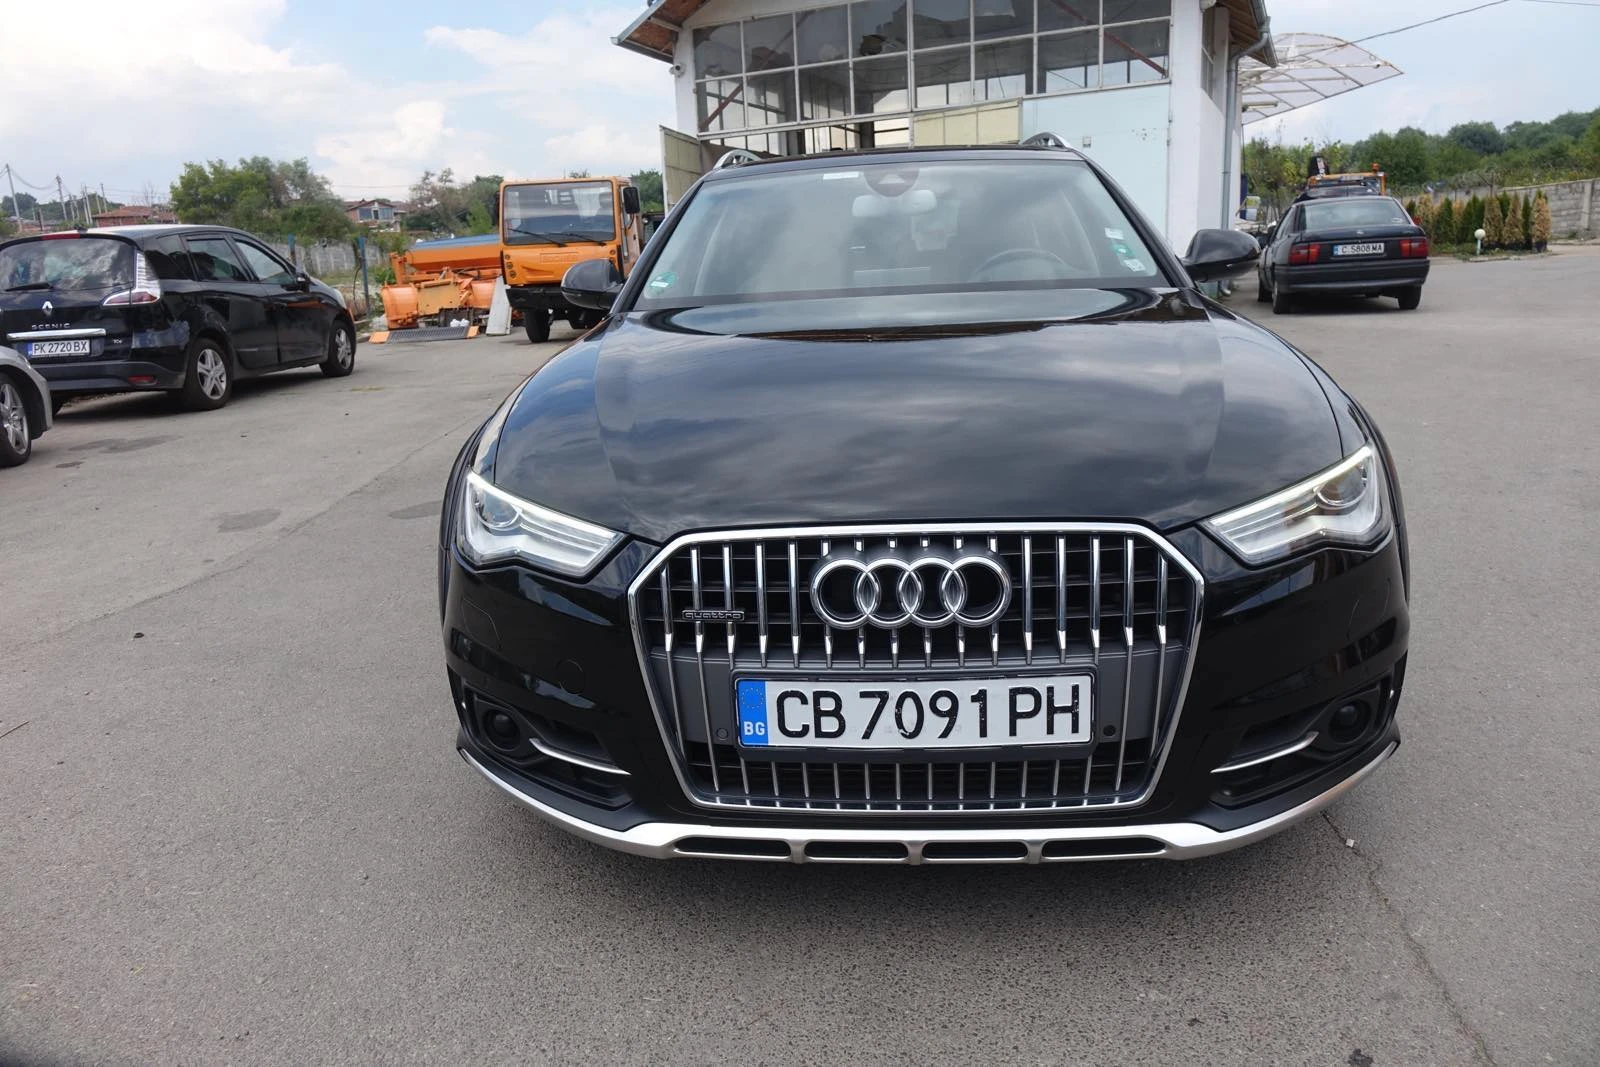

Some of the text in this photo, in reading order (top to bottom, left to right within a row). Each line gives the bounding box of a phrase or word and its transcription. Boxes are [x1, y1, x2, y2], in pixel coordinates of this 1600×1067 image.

[34, 343, 46, 354] PK
[48, 342, 72, 353] 2720
[73, 341, 87, 352] BX
[776, 684, 1079, 740] CB 7091 PH
[744, 721, 765, 735] BG
